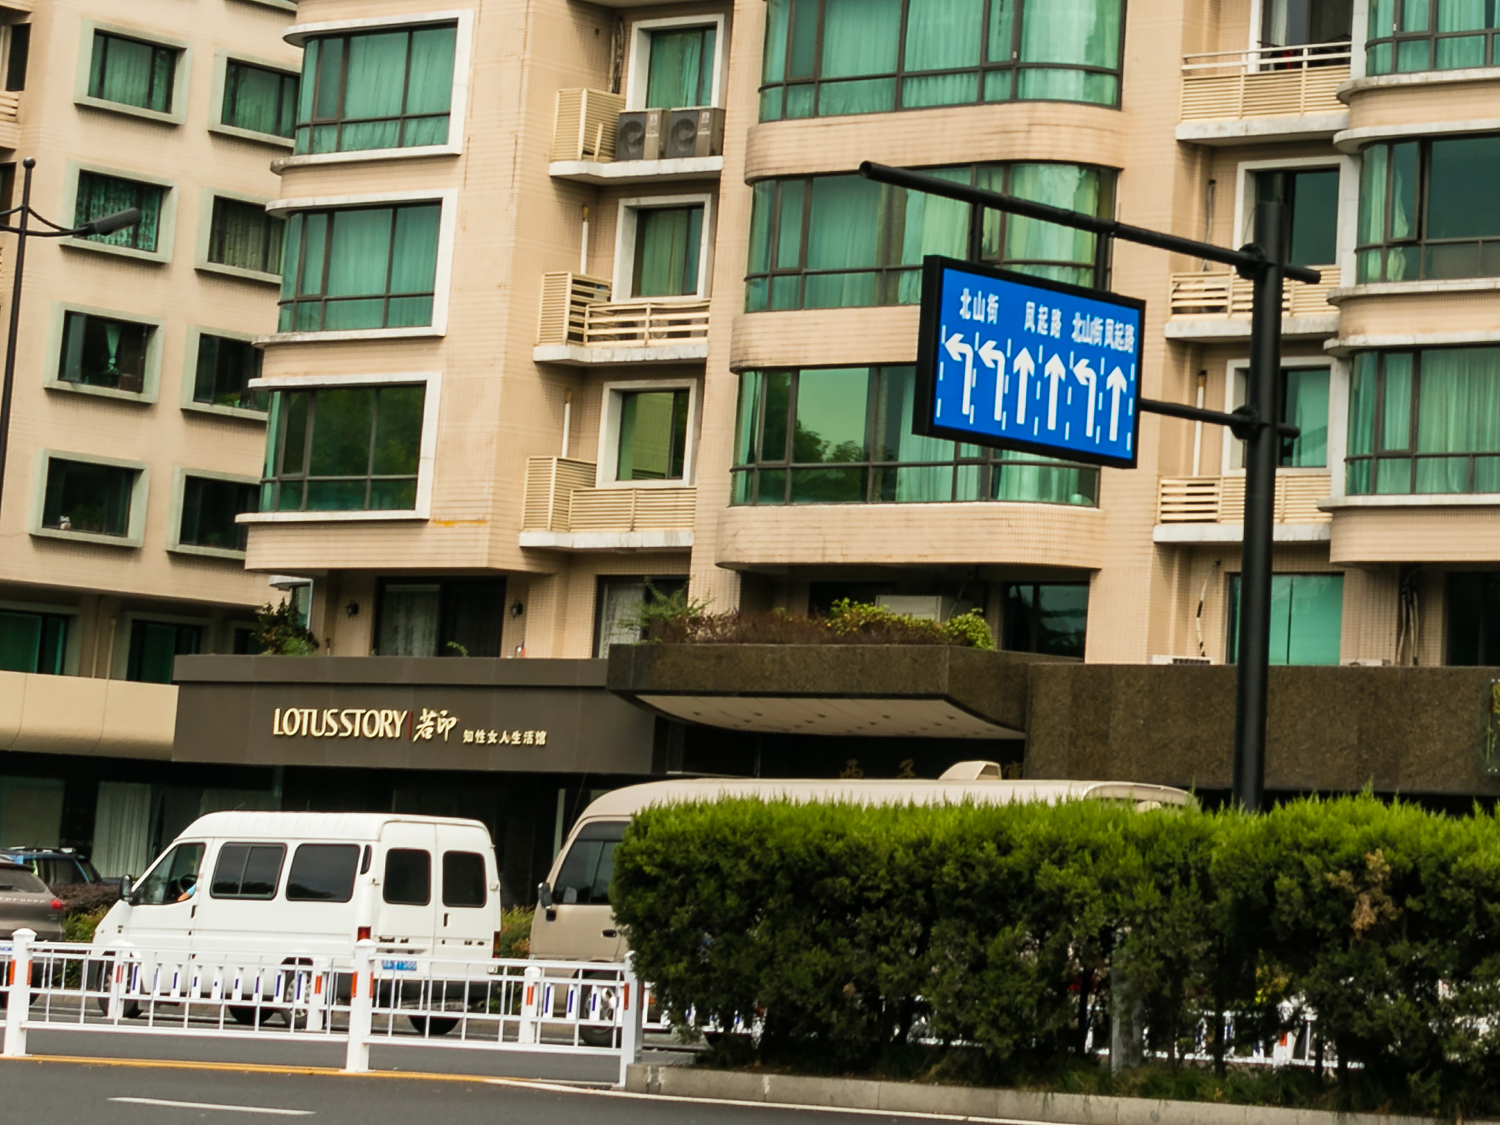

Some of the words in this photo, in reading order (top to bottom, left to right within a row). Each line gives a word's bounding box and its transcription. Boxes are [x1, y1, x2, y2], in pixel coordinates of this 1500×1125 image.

[960, 288, 999, 324] 北山街
[463, 729, 546, 746] 知性女人生活馆
